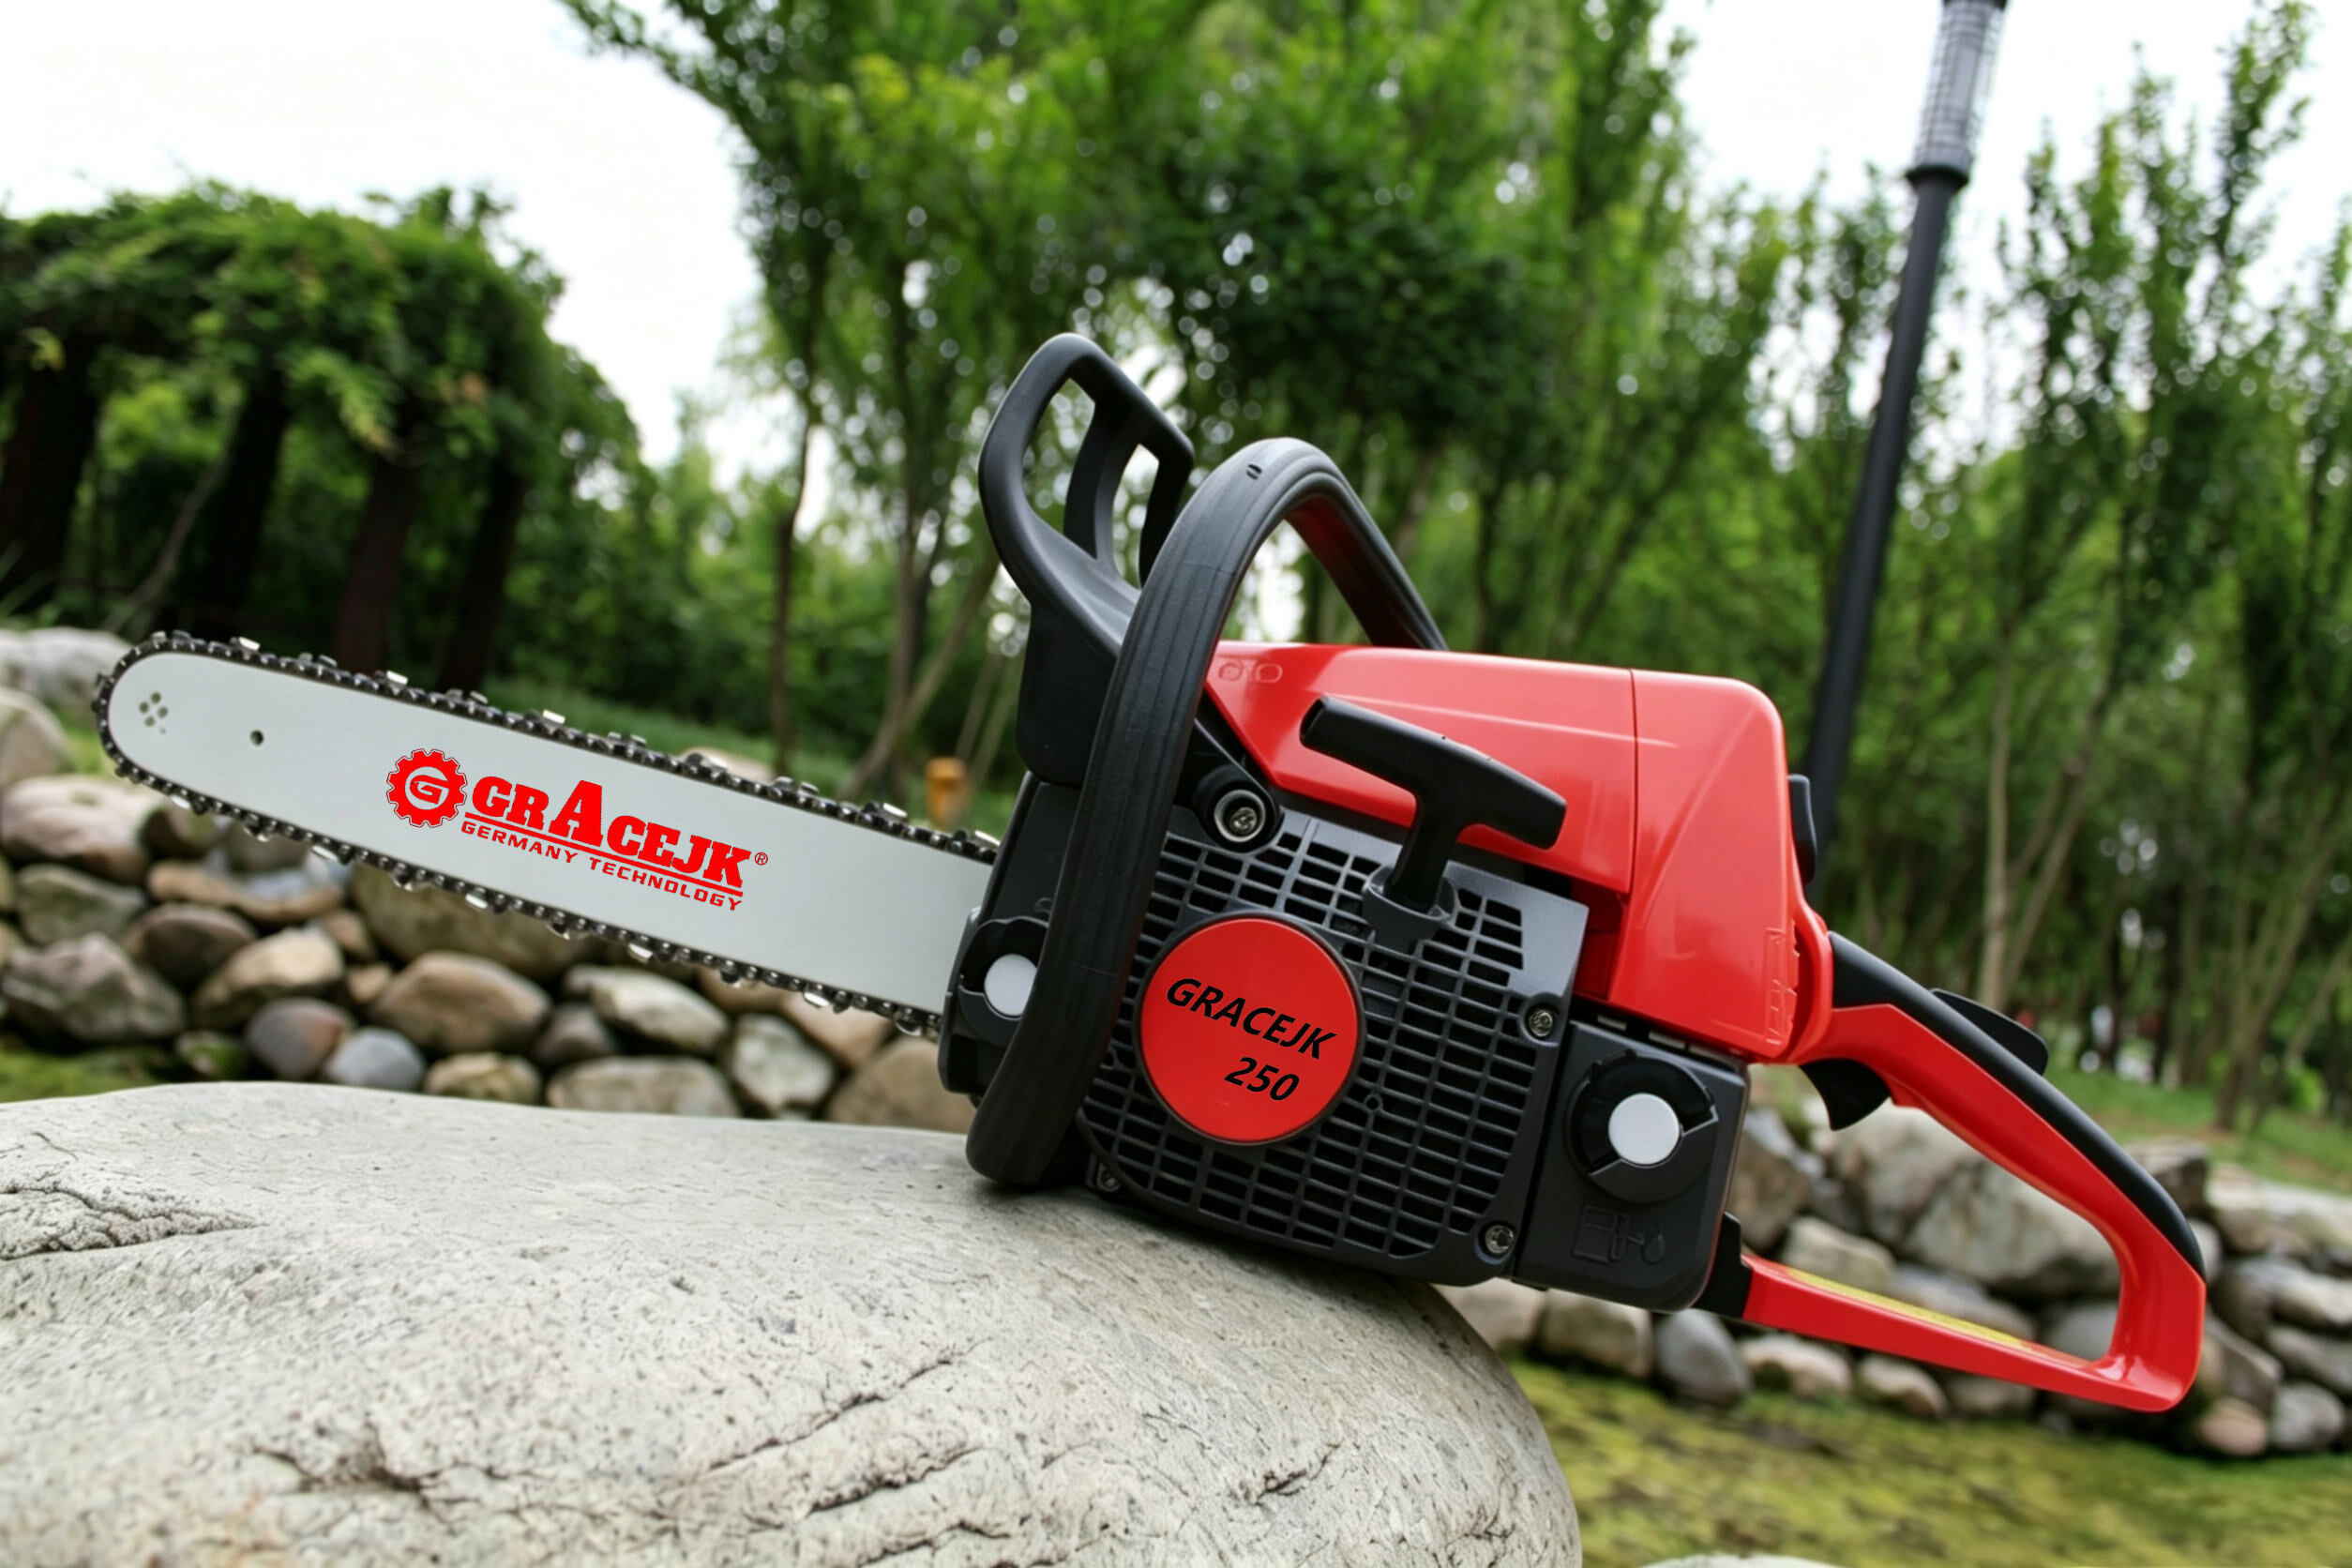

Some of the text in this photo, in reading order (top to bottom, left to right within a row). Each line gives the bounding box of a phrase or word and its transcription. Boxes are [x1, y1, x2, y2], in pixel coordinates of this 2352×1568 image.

[460, 821, 743, 912] GERMANY TECHNOLOGY
[472, 776, 752, 889] GRACEJK
[1167, 978, 1338, 1060] GRACEJK
[1223, 1056, 1300, 1101] 250
